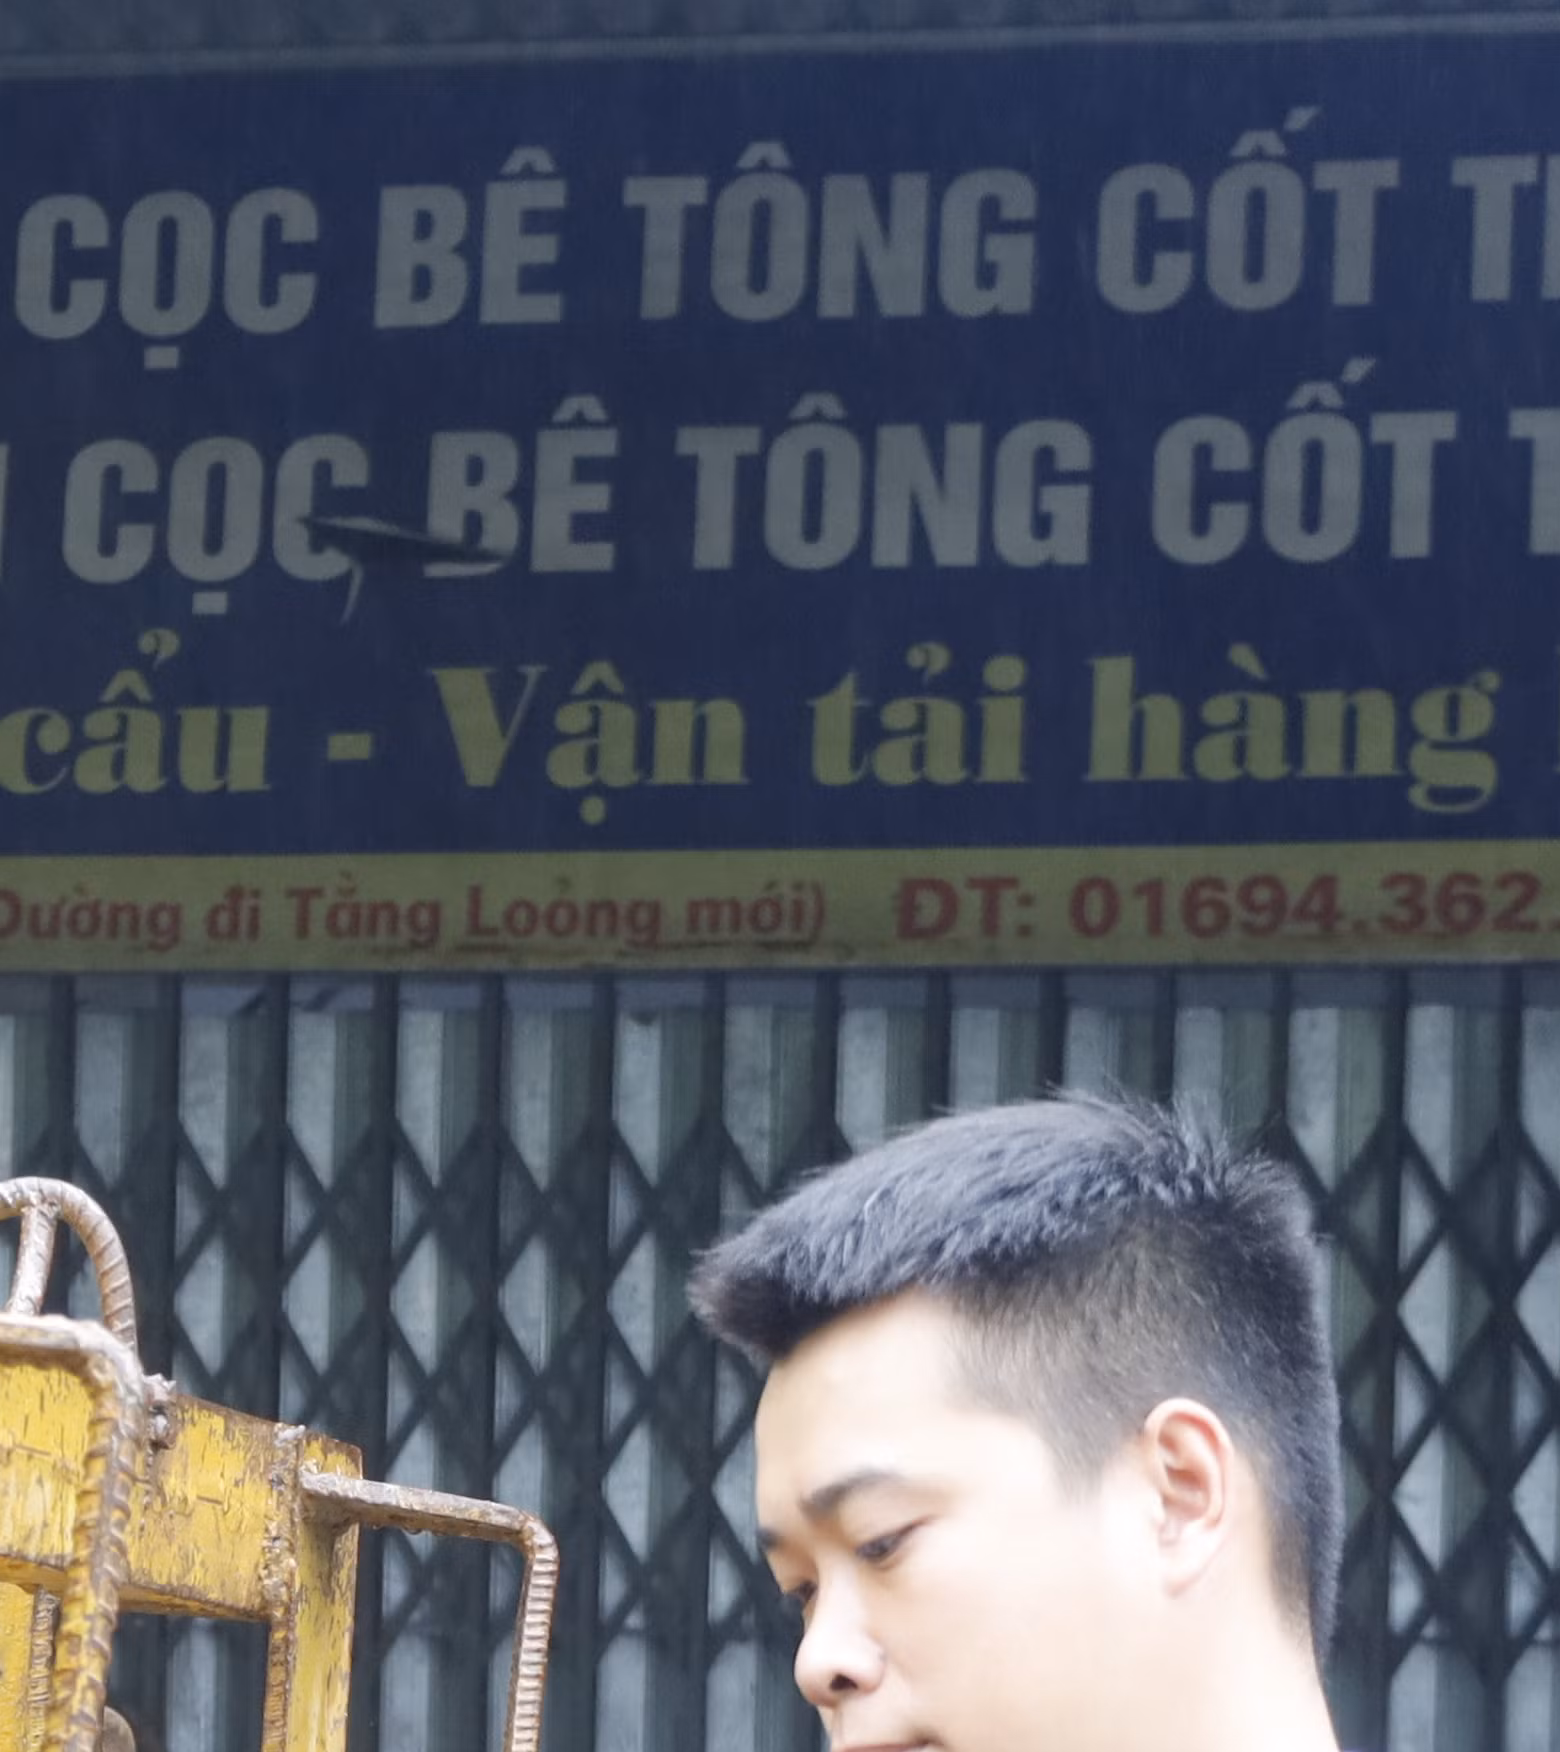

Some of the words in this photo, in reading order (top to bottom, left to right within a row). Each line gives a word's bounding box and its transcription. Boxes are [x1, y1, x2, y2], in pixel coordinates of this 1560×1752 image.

[14, 187, 319, 369] CỌC
[373, 145, 567, 328] BÊ
[623, 140, 1038, 322] TÔNG
[1096, 105, 1400, 313] CỐT
[62, 434, 370, 615] CỌC
[423, 394, 618, 578] BÊ
[676, 391, 1094, 570] TÔNG
[1151, 357, 1458, 565] CỐT
[428, 660, 748, 825] Vận
[807, 640, 1028, 787] tải
[1086, 642, 1502, 813] hàng
[203, 884, 261, 940] đi
[686, 880, 824, 947] mới)
[897, 877, 1037, 940] ĐT:
